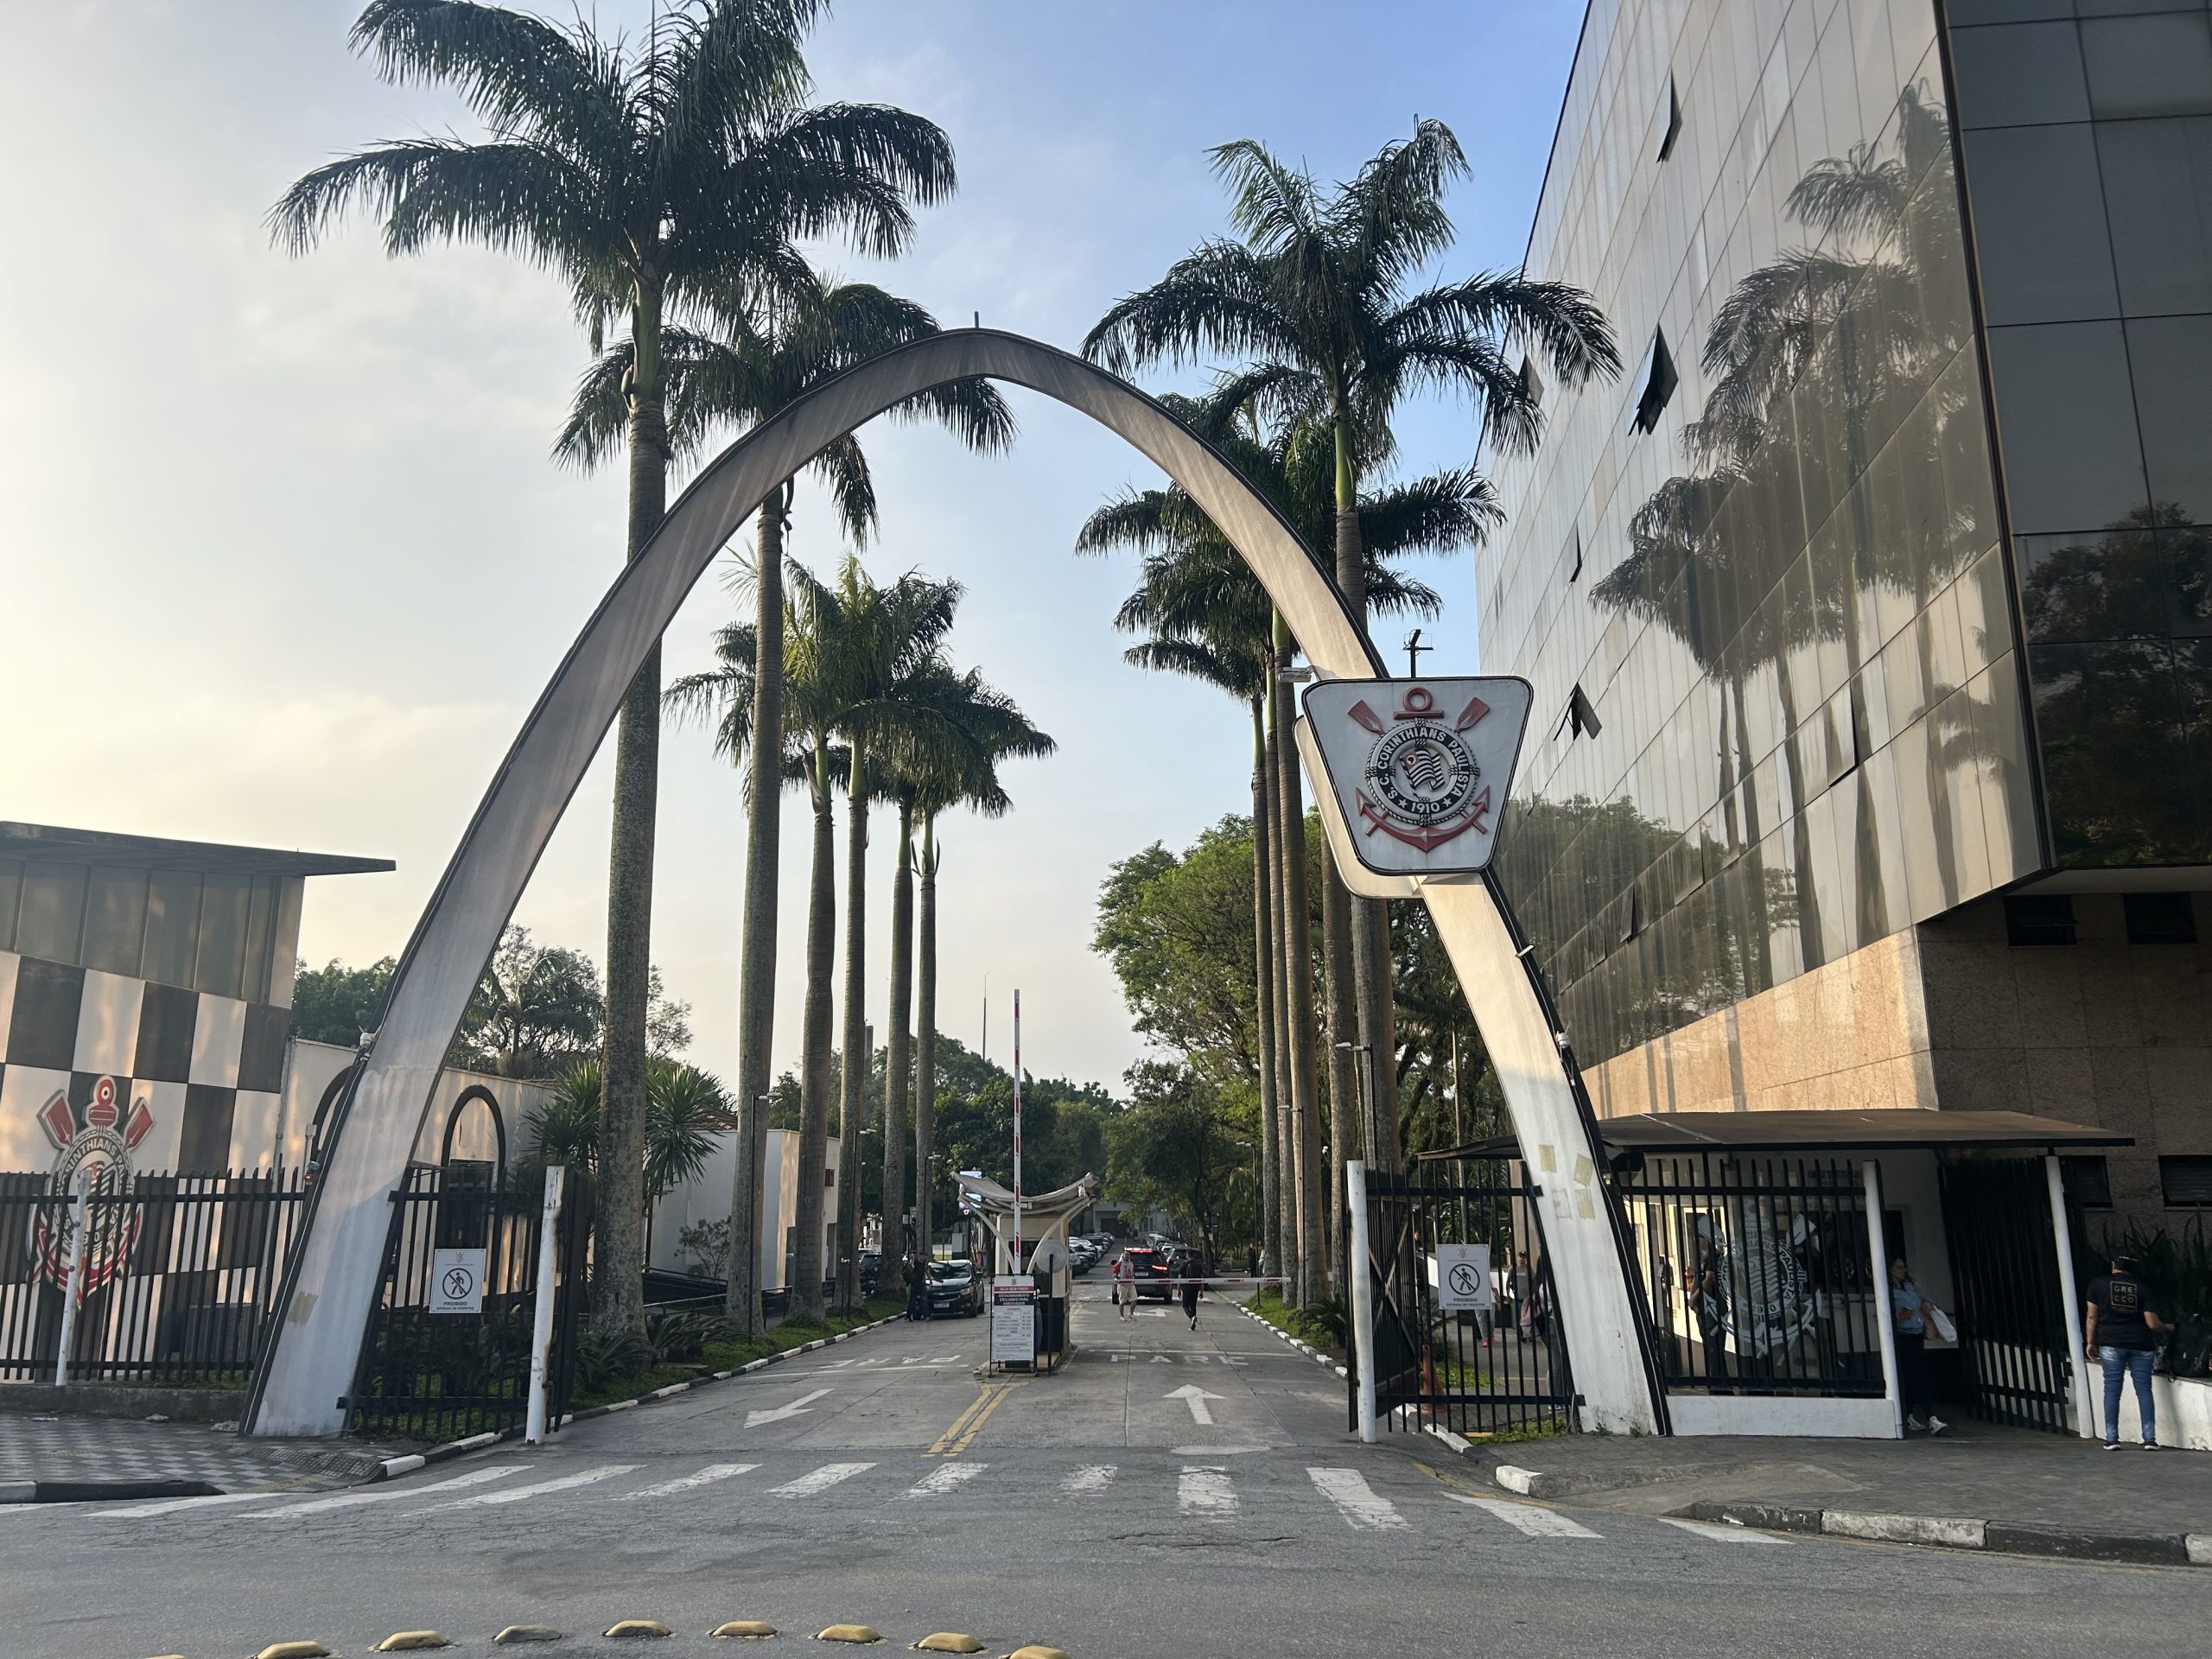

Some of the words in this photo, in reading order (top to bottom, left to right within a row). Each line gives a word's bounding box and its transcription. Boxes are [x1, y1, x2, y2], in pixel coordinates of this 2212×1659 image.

[1377, 727, 1446, 769] CORINTHIANS
[1447, 740, 1469, 798] PAULISTA
[1379, 773, 1389, 785] C.
[1387, 787, 1397, 799] S.
[1411, 802, 1440, 813] 1910
[2113, 1285, 2133, 1294] GRE
[1110, 1354, 1249, 1366] PARE
